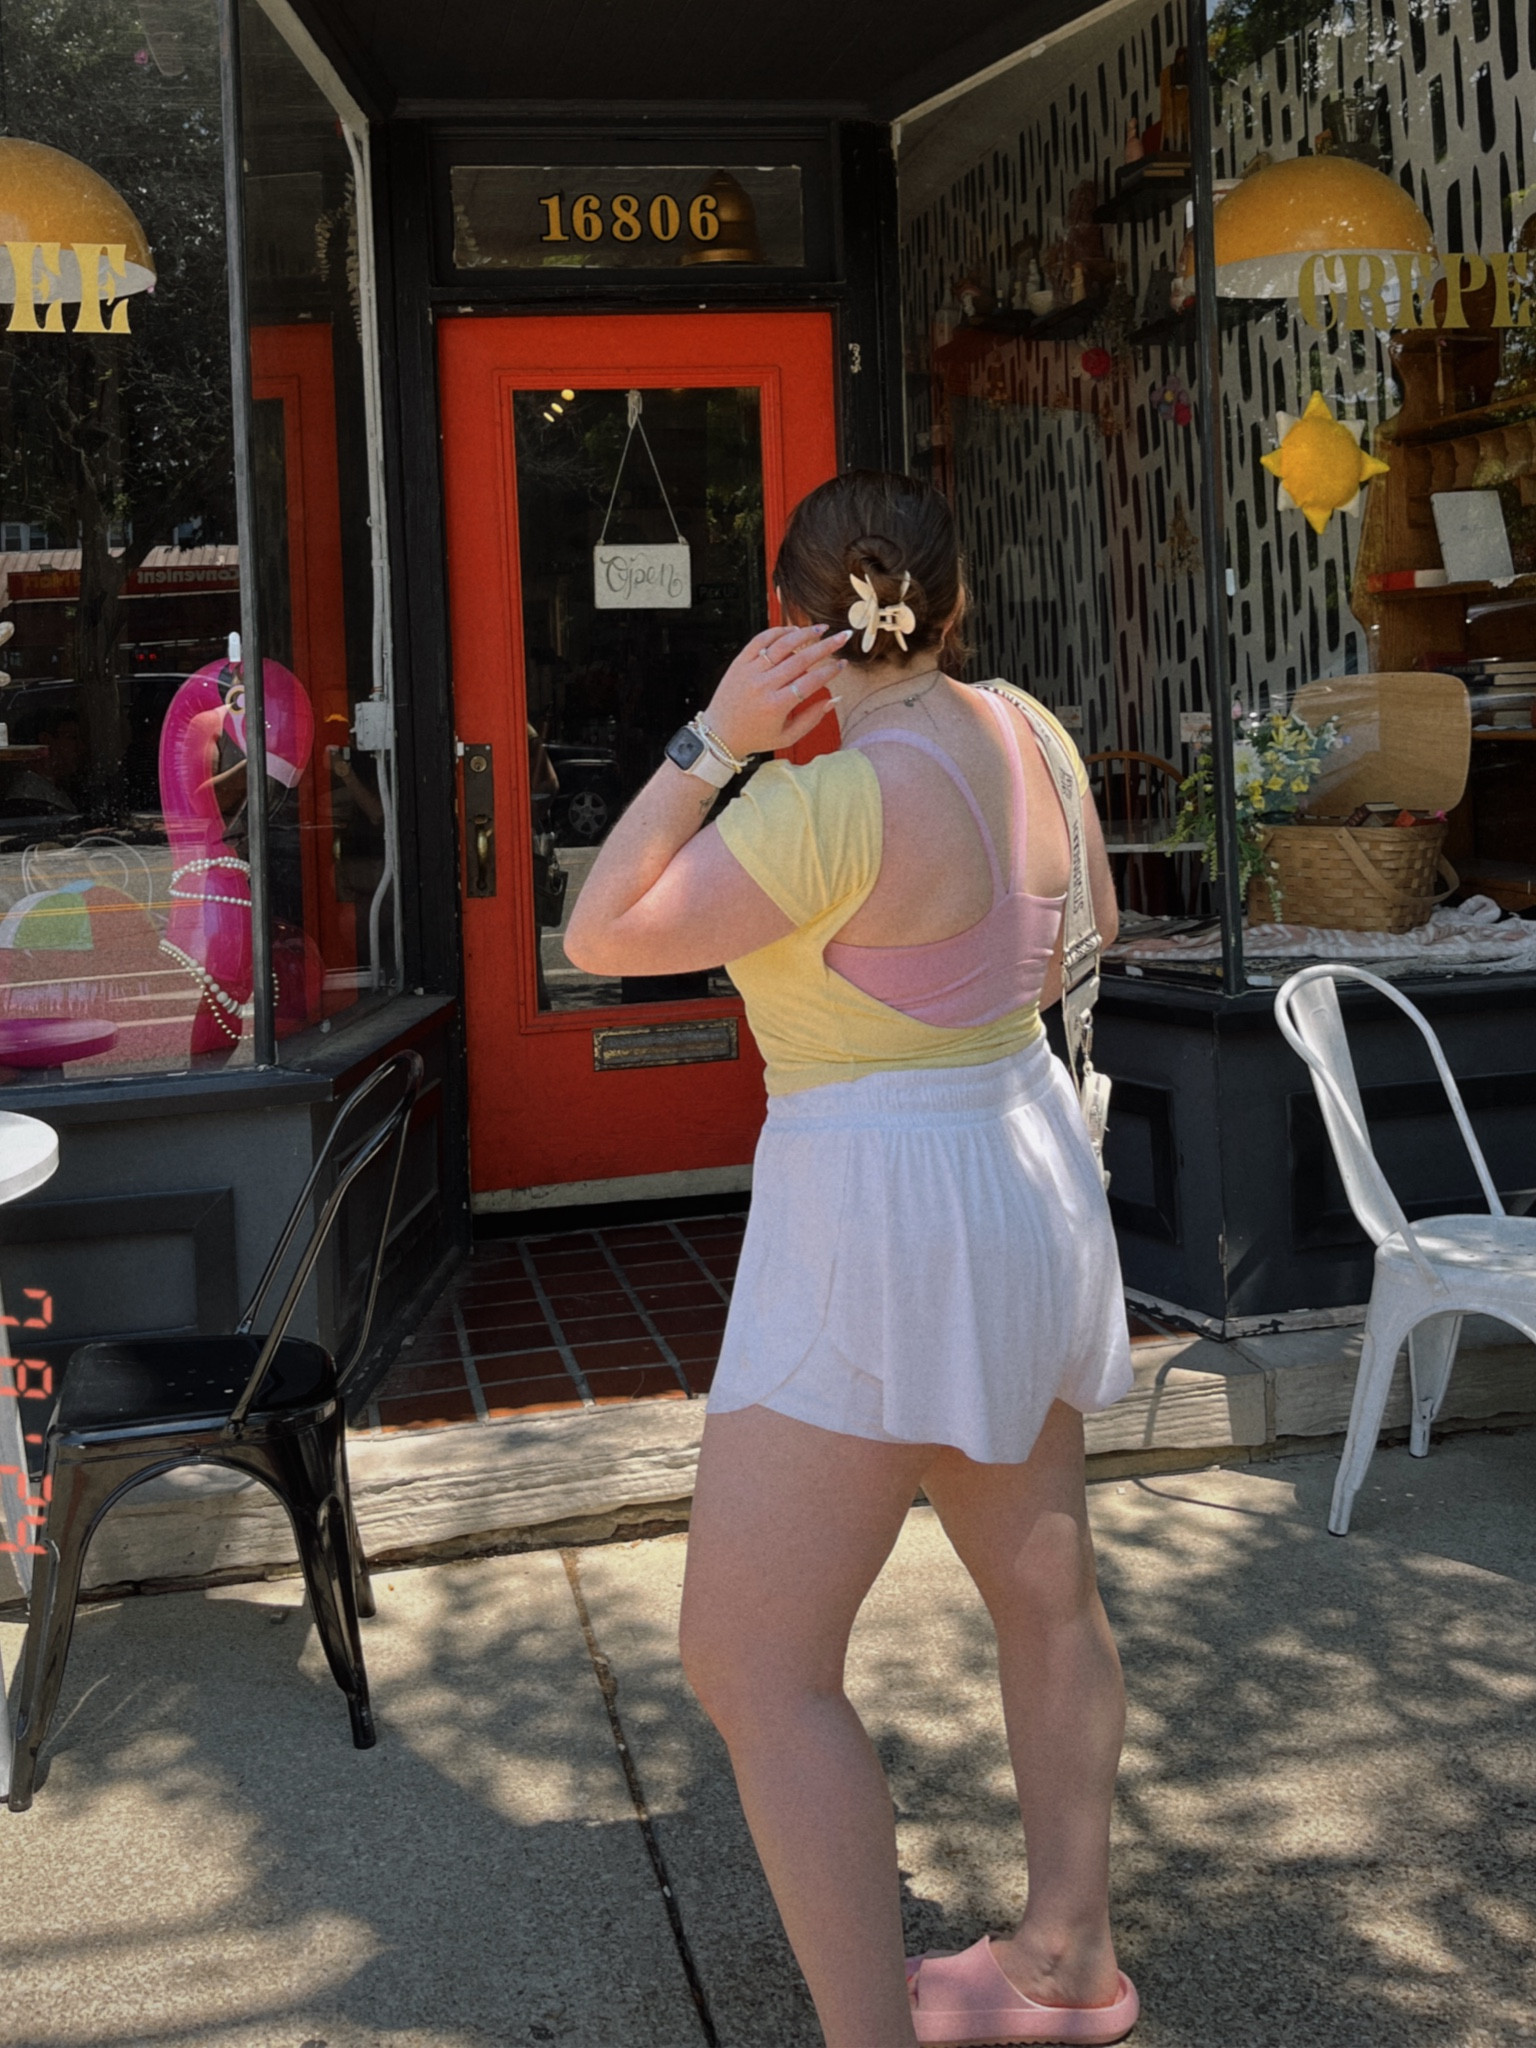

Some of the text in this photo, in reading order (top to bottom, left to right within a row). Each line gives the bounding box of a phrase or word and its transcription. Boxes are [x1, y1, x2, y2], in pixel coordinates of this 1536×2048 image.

[539, 194, 721, 243] 16806
[5, 241, 132, 334] EE
[1298, 252, 1533, 331] CREPE
[599, 553, 683, 600] Open
